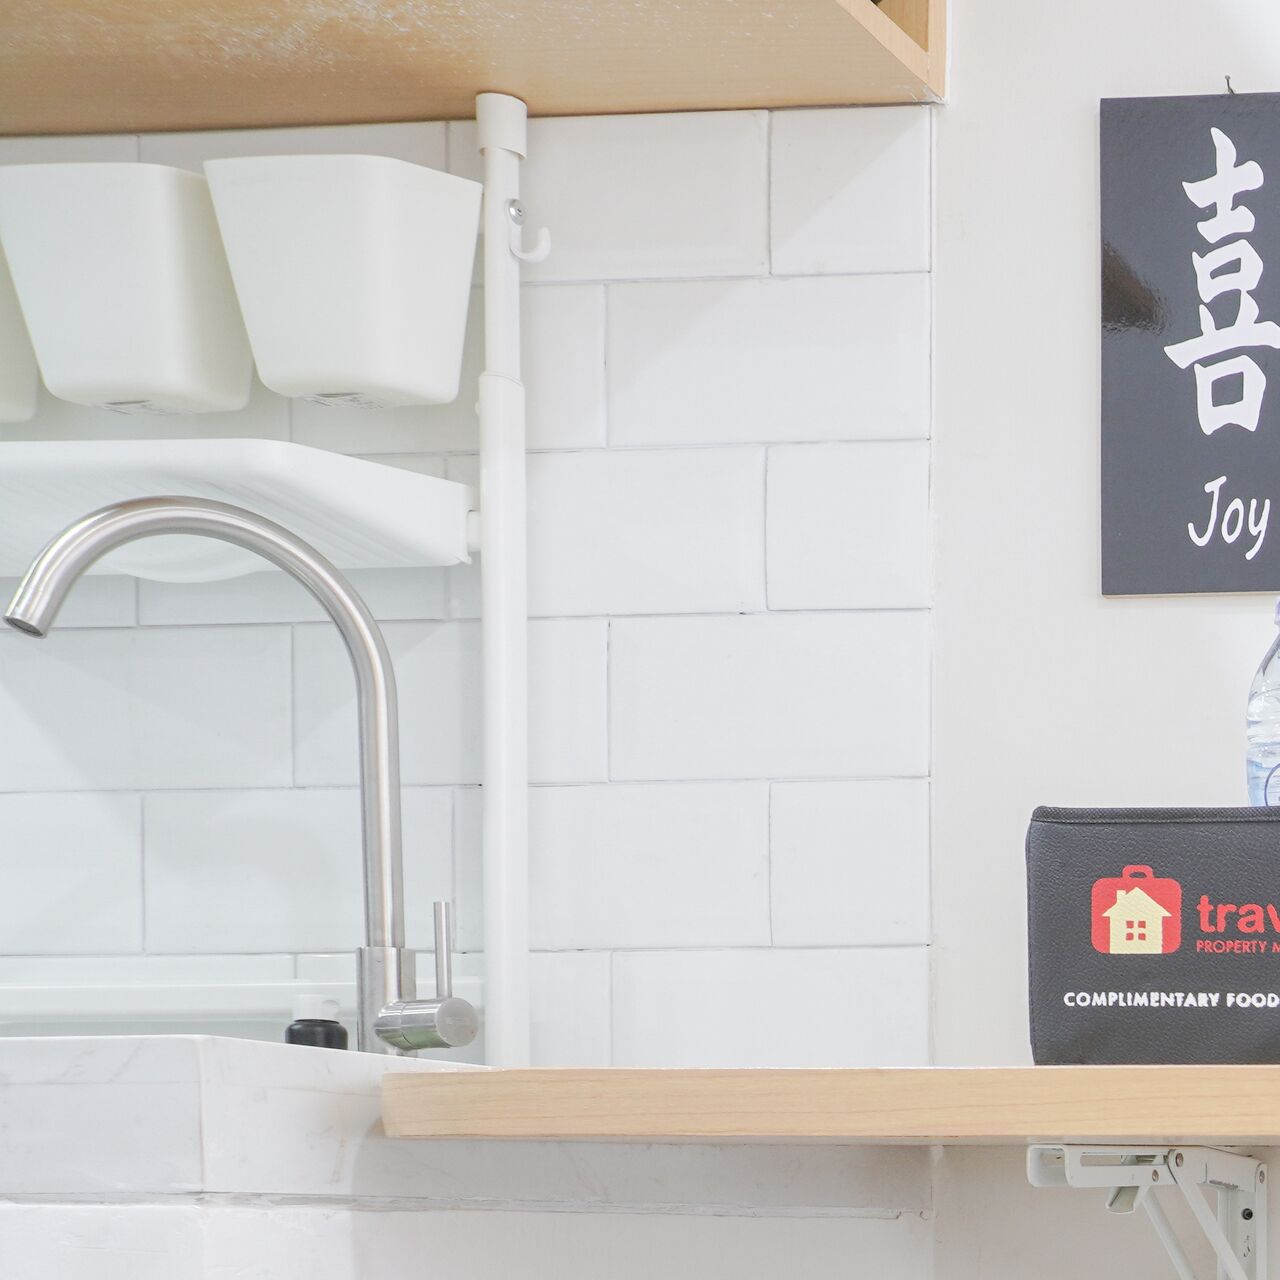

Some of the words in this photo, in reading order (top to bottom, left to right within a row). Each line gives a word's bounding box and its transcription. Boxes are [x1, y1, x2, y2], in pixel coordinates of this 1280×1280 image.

[1187, 475, 1272, 561] Joy
[1196, 940, 1267, 954] PROPERTY
[1063, 992, 1220, 1008] COMPLIMENTARY
[1226, 992, 1280, 1008] FOOD
